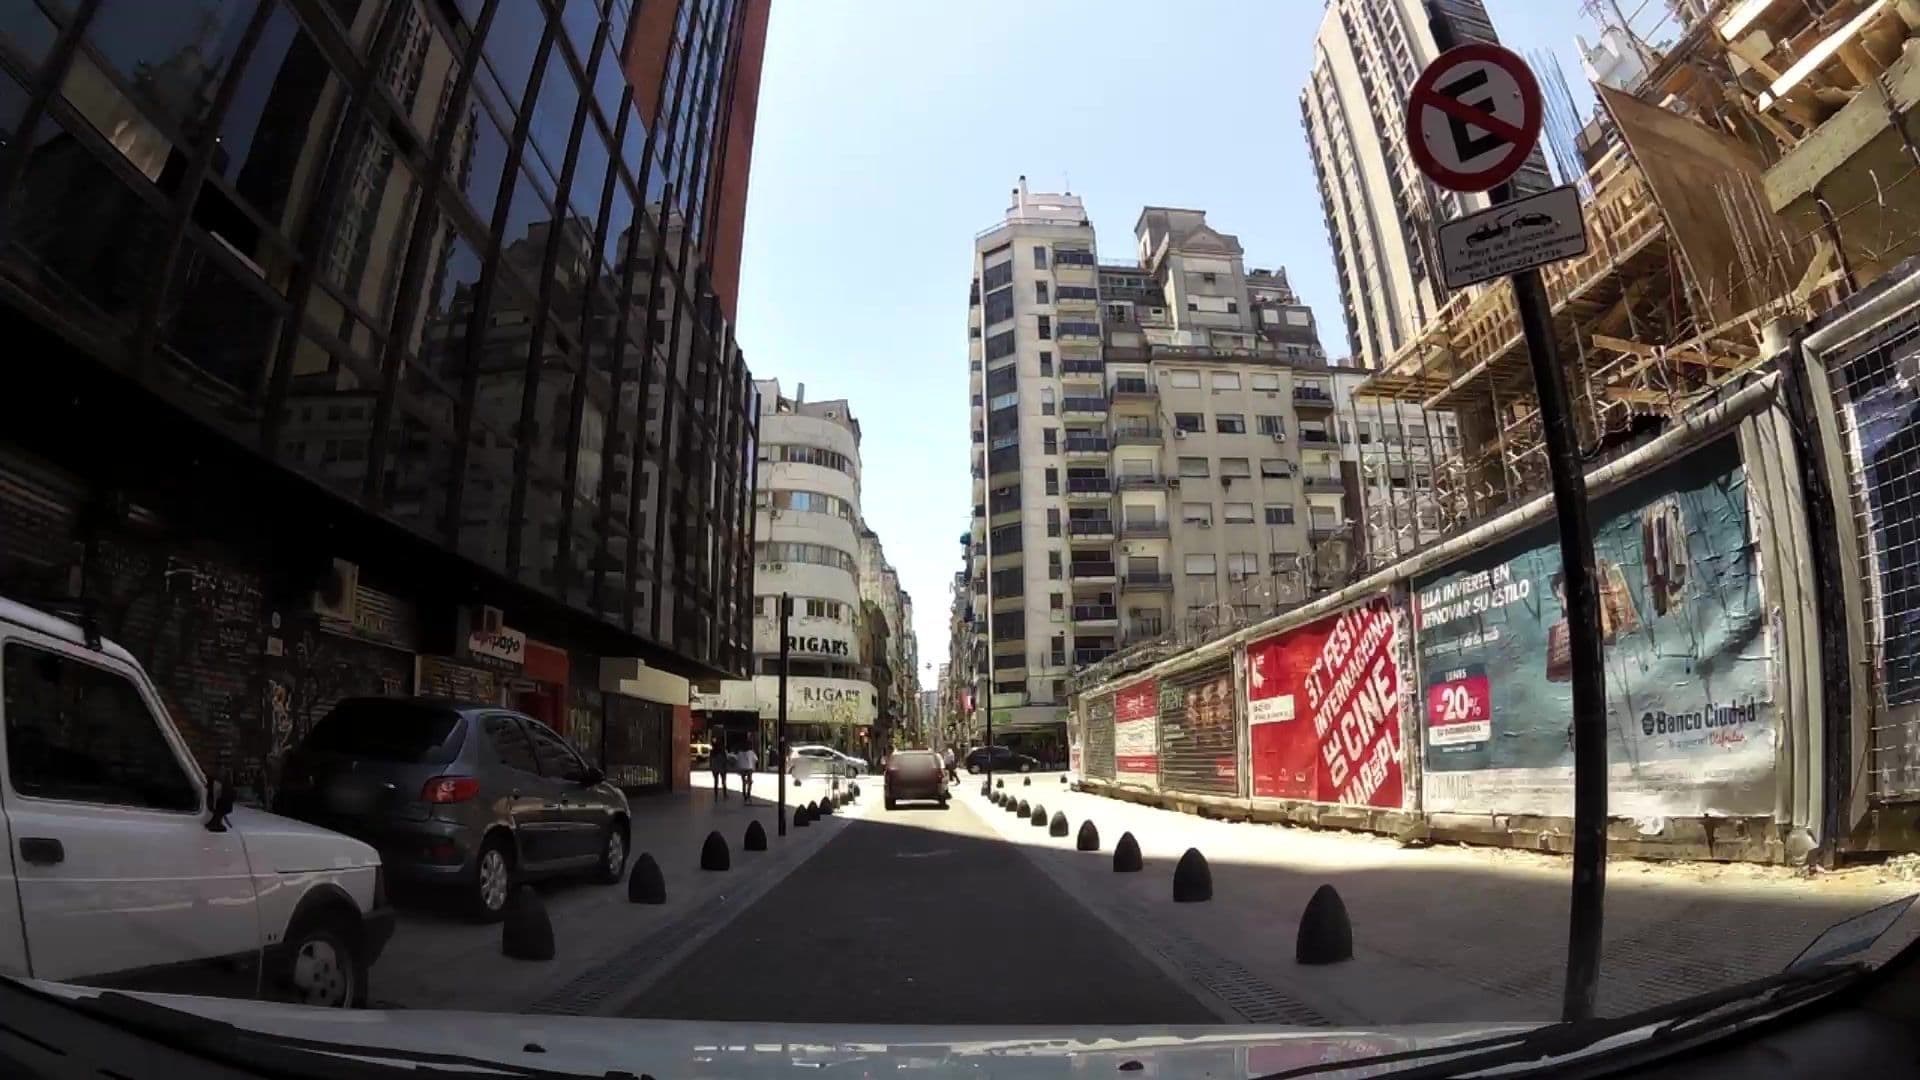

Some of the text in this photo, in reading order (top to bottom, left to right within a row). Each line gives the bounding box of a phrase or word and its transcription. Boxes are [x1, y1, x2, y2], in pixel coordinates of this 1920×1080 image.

[1439, 68, 1514, 163] E
[1494, 562, 1510, 584] EN
[1472, 592, 1489, 613] SU
[1491, 579, 1529, 608] ESTILO
[1340, 656, 1398, 762] CINE
[1657, 711, 1702, 734] Banco
[1704, 697, 1756, 728] Ciudad
